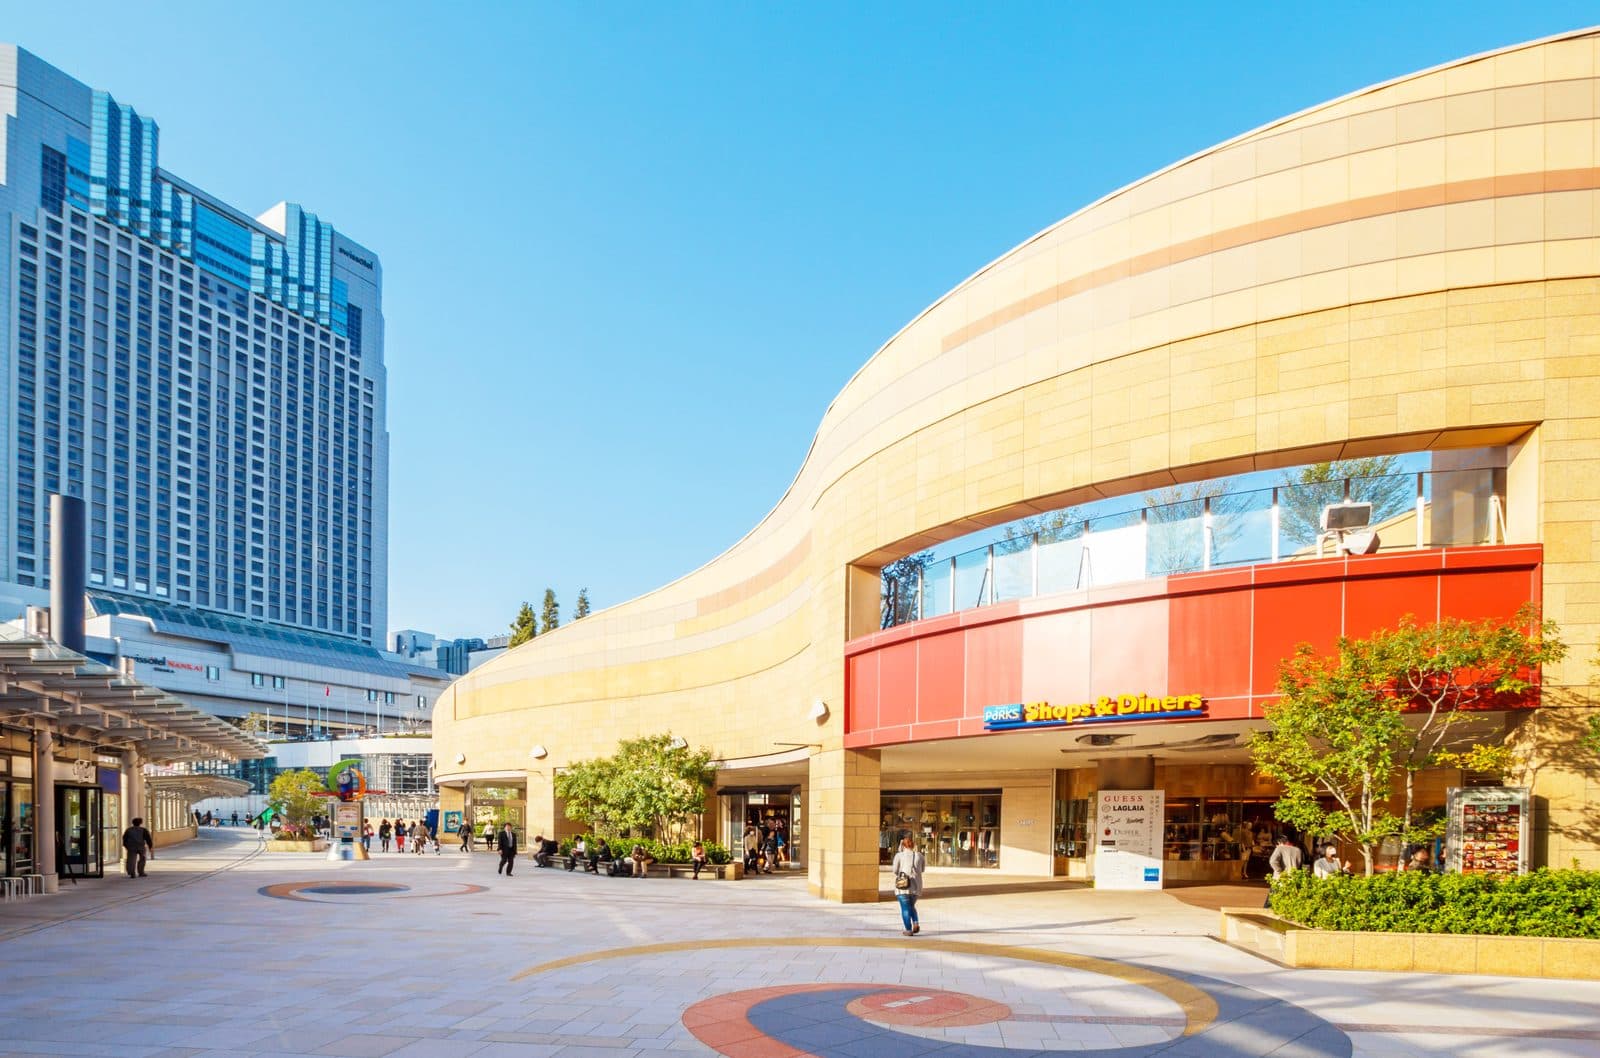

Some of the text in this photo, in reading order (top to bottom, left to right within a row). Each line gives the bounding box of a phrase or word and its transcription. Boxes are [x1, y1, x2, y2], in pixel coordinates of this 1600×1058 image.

[1025, 702, 1091, 722] Shops
[1095, 695, 1113, 715] &
[1117, 692, 1202, 714] Diners
[1104, 795, 1143, 803] GUESS
